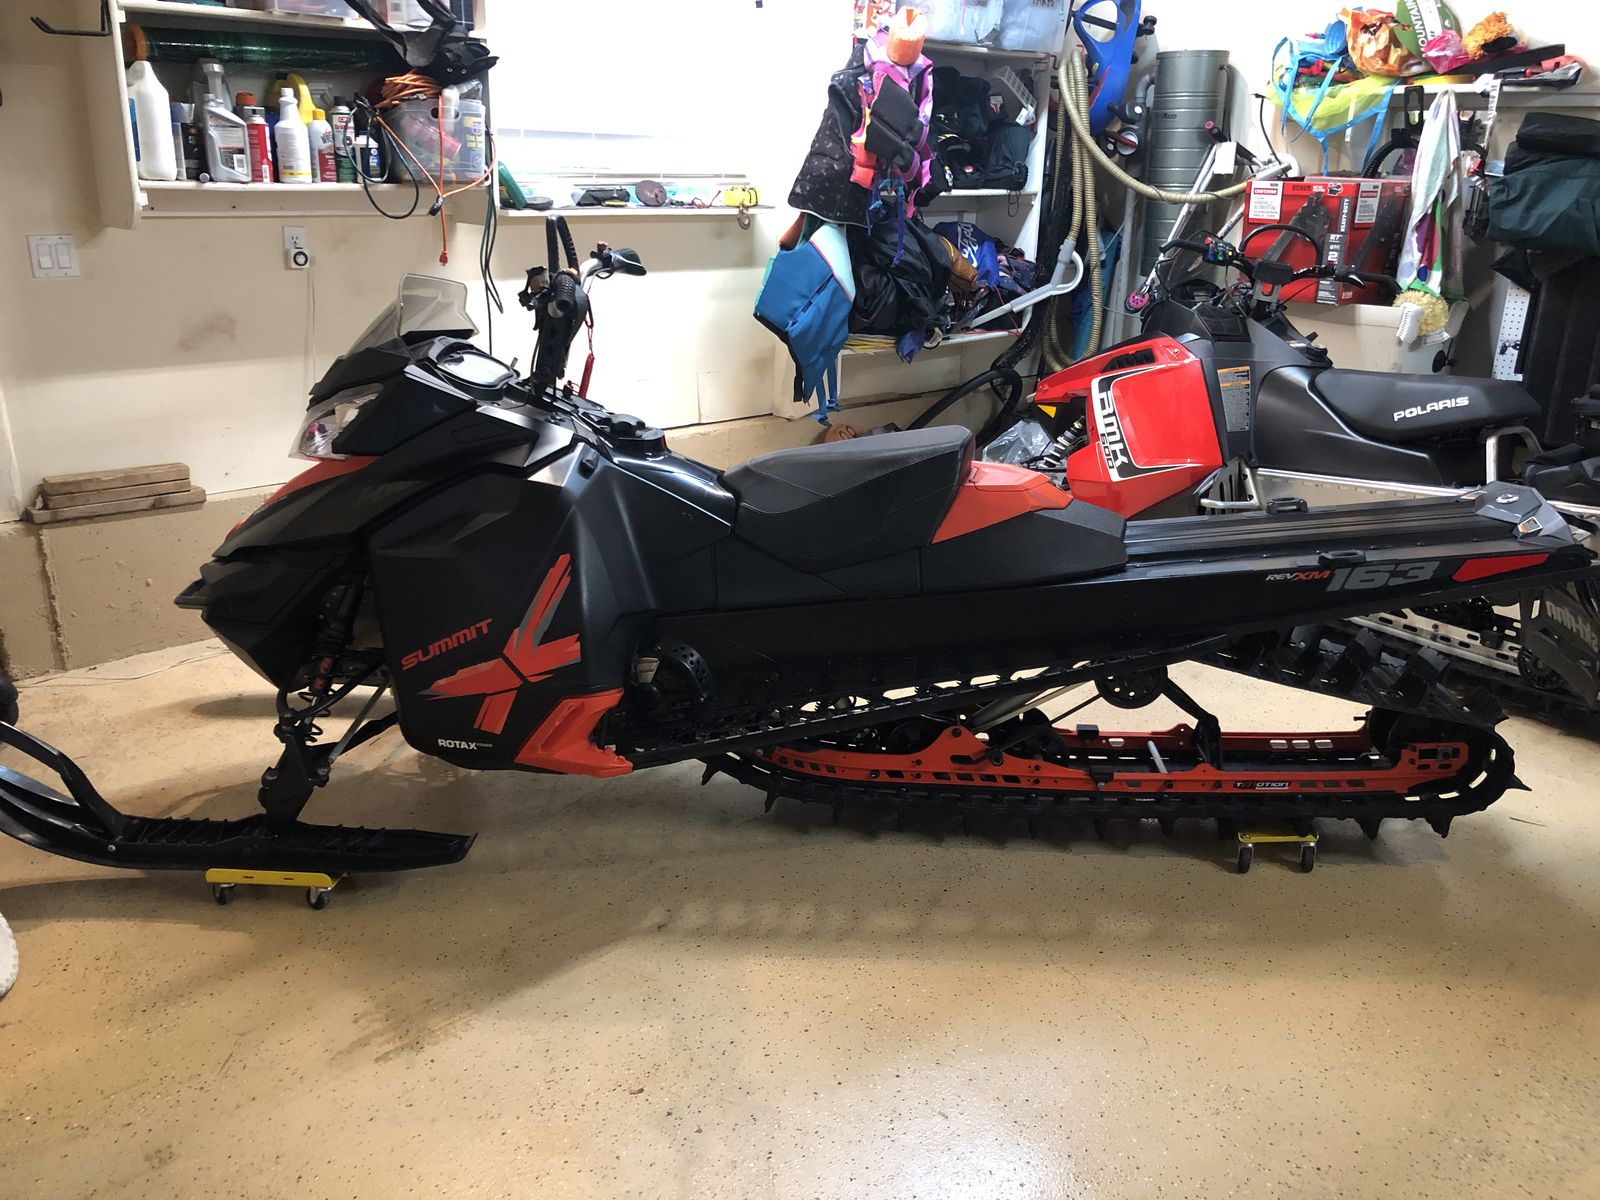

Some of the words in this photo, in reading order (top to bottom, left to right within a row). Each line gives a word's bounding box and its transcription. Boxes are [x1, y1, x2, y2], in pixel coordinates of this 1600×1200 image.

[1393, 396, 1469, 422] POLARIS
[1100, 390, 1129, 468] RMK
[1326, 561, 1441, 592] 163
[401, 618, 493, 671] SUMMIT
[437, 739, 478, 750] ROTAX
